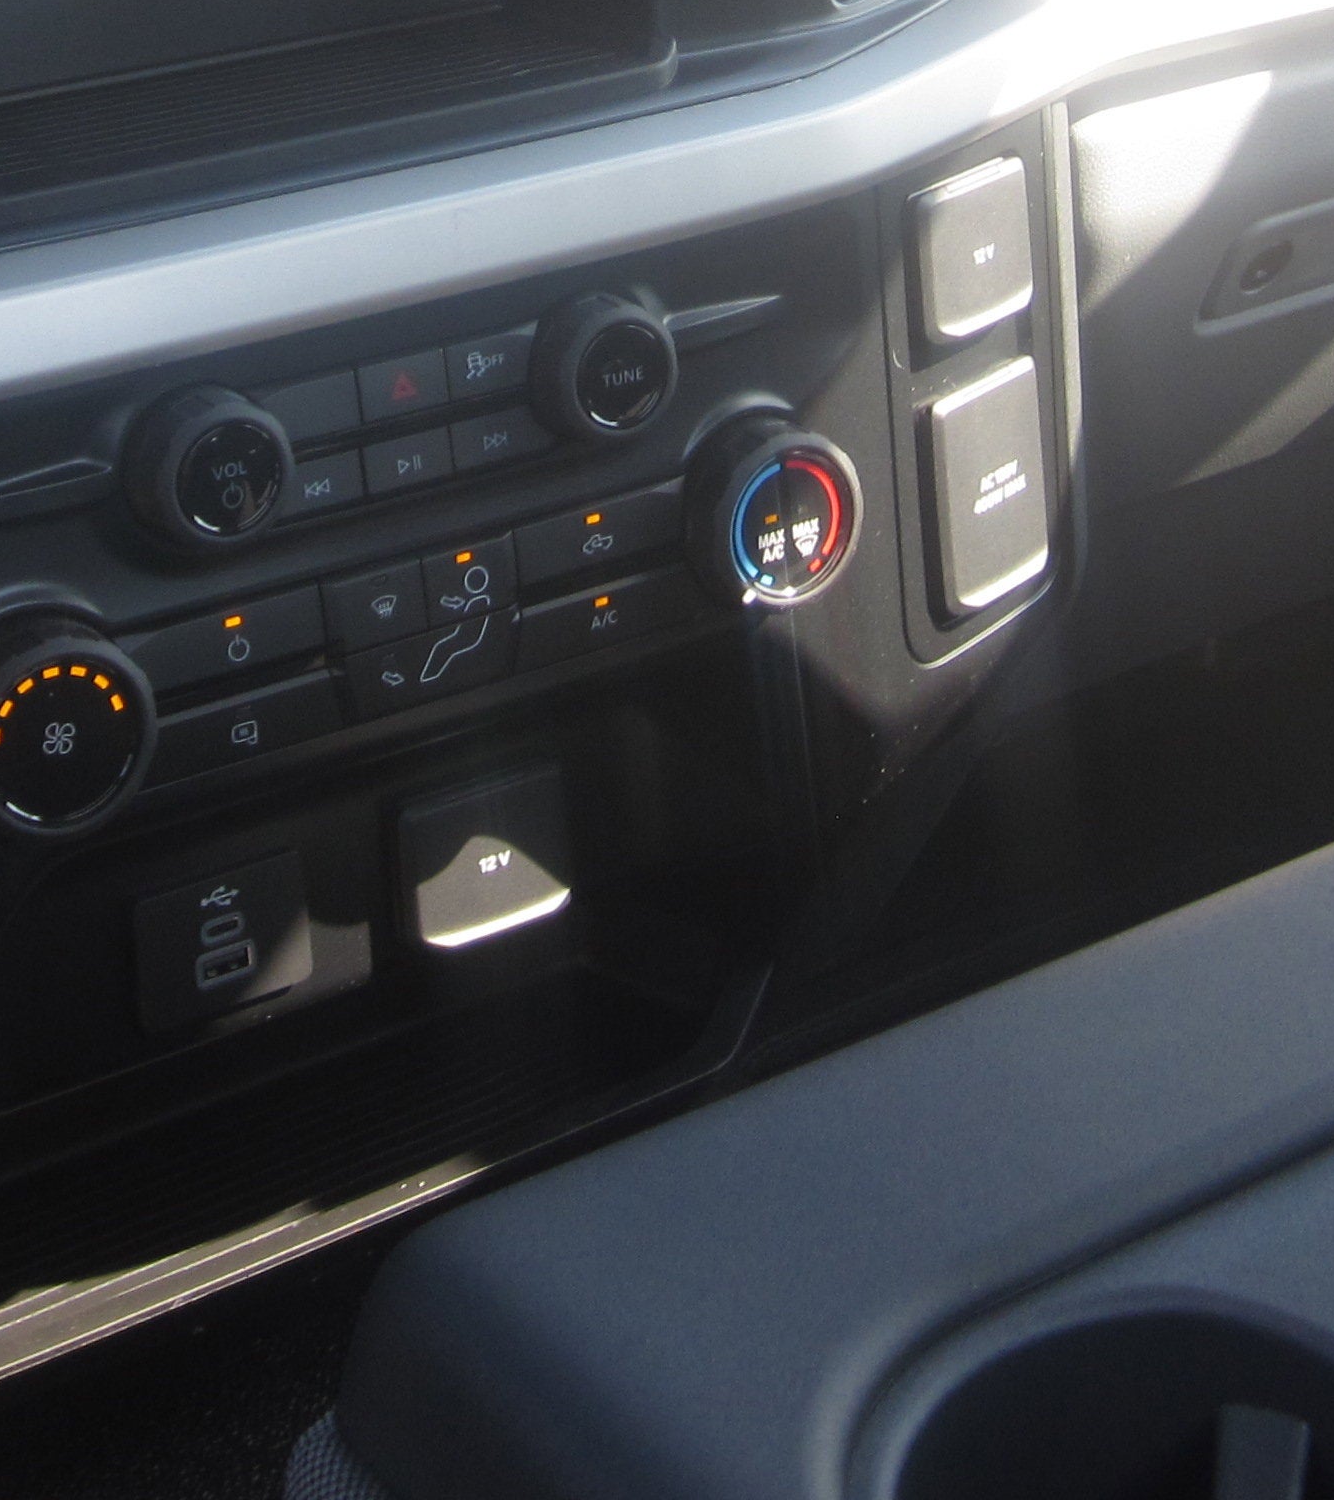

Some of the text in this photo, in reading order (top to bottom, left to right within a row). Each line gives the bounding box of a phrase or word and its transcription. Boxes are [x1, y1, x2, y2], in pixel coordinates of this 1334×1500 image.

[482, 351, 505, 369] OFF
[602, 366, 644, 388] TUNE
[211, 460, 247, 480] VOL
[758, 528, 786, 550] MAX
[792, 516, 820, 540] MAX
[762, 543, 785, 565] A/C
[591, 609, 618, 628] A/C
